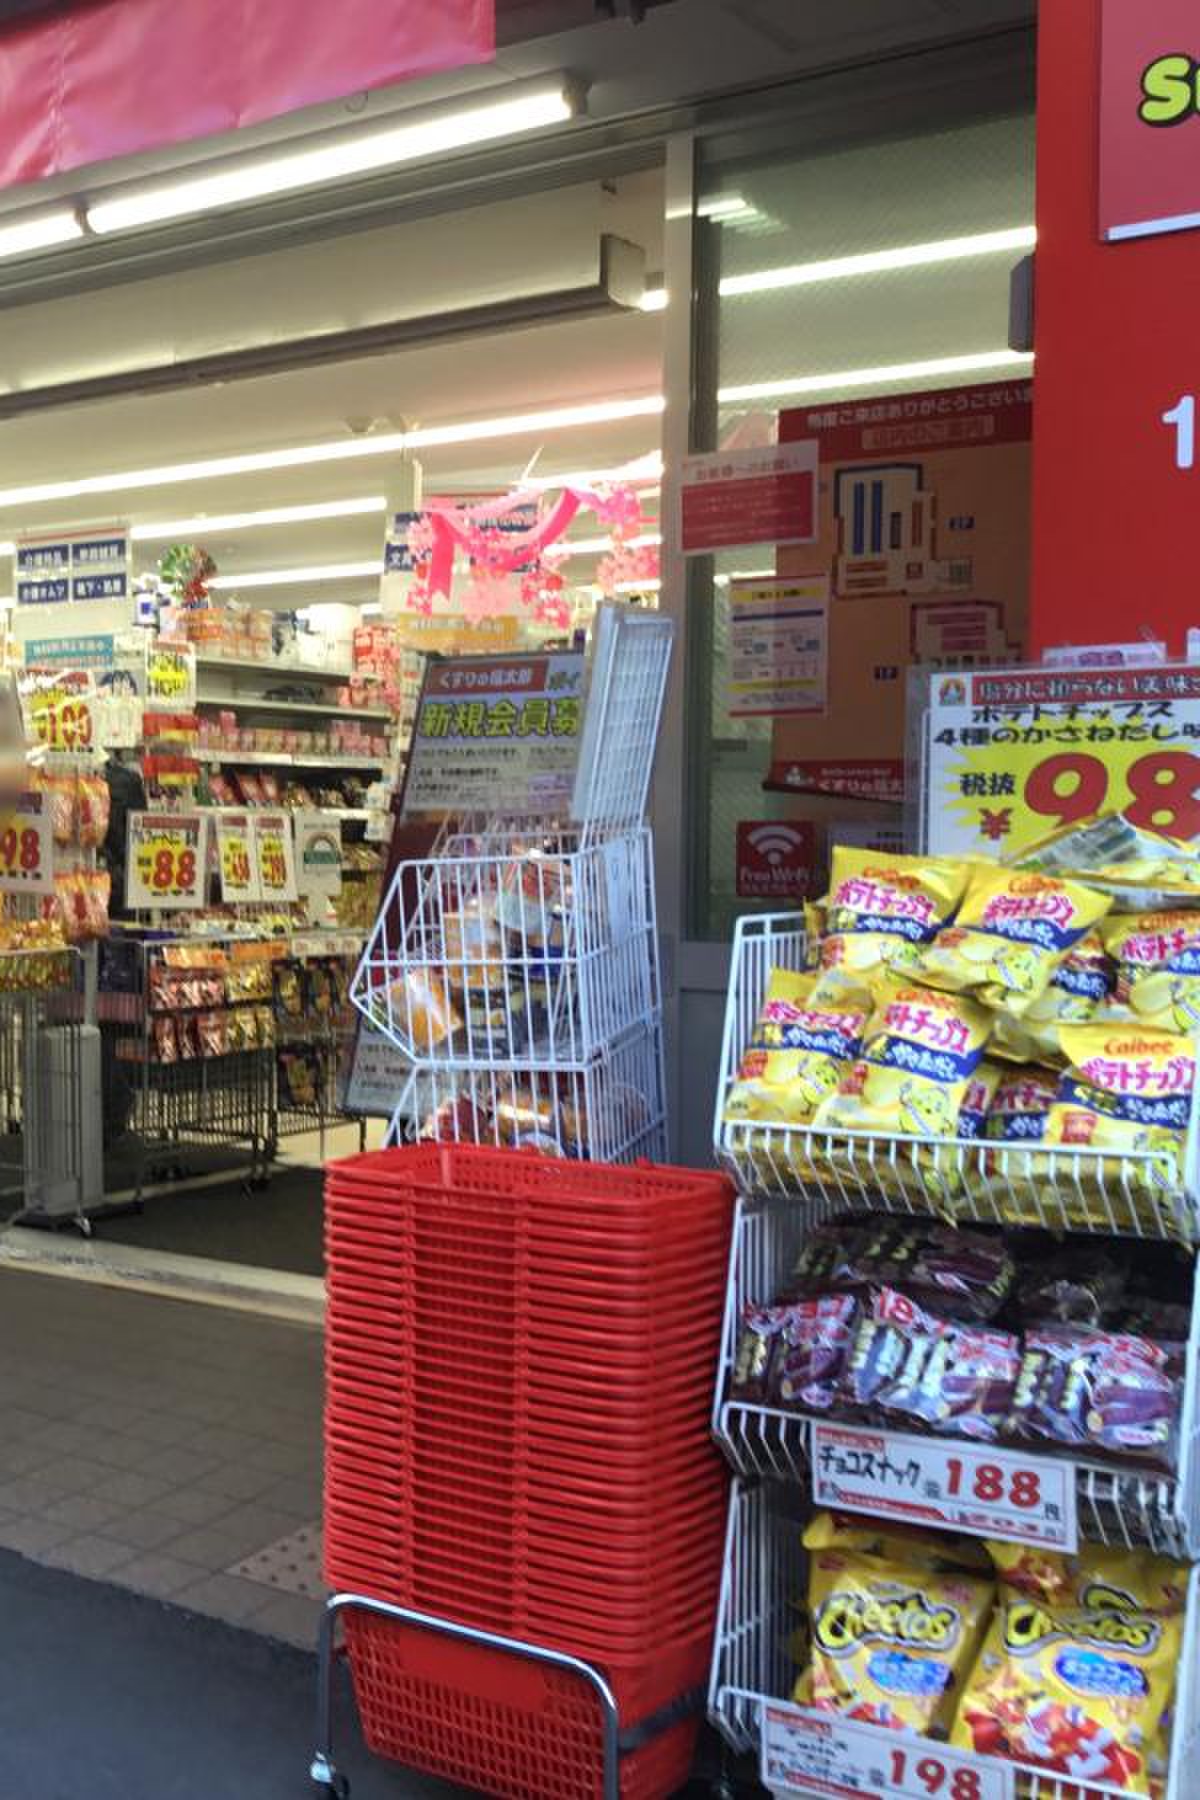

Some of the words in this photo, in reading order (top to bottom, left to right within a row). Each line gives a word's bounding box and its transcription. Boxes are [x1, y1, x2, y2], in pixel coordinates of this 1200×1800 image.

[1140, 55, 1200, 124] S
[438, 667, 533, 687] くすりの福太郎
[972, 701, 1174, 723] ポテトチップス
[960, 772, 1016, 796] 税抜
[153, 850, 196, 888] 88
[1104, 1037, 1175, 1056] Calbee
[818, 1446, 921, 1487] チョコスナック
[946, 1459, 1041, 1508] 188
[890, 1750, 981, 1800] 198
